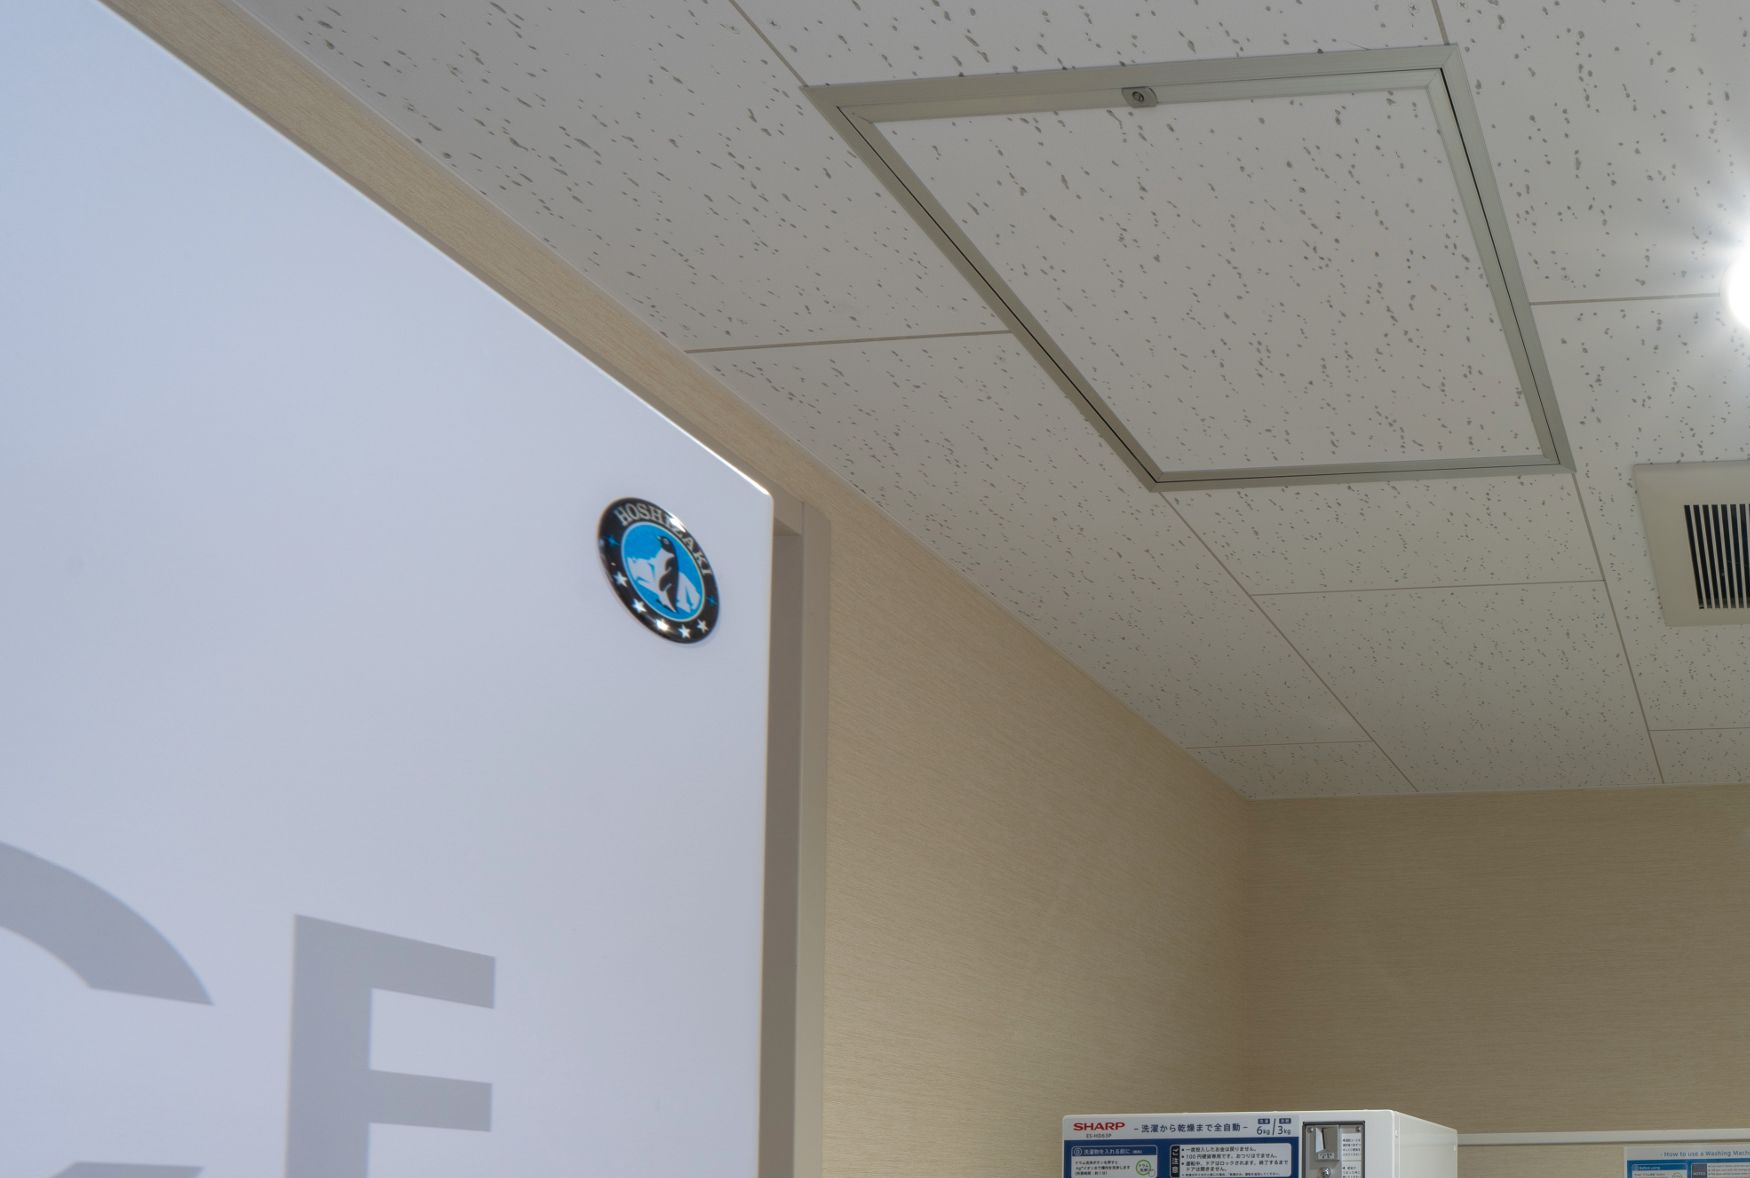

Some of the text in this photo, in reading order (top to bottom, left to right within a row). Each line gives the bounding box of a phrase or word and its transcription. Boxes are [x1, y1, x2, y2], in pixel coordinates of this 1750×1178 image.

[1074, 1122, 1125, 1131] SHARP
[1141, 1124, 1240, 1133] 洗濯から乾燥まで全自動
[1257, 1125, 1291, 1135] 6kg 3kg
